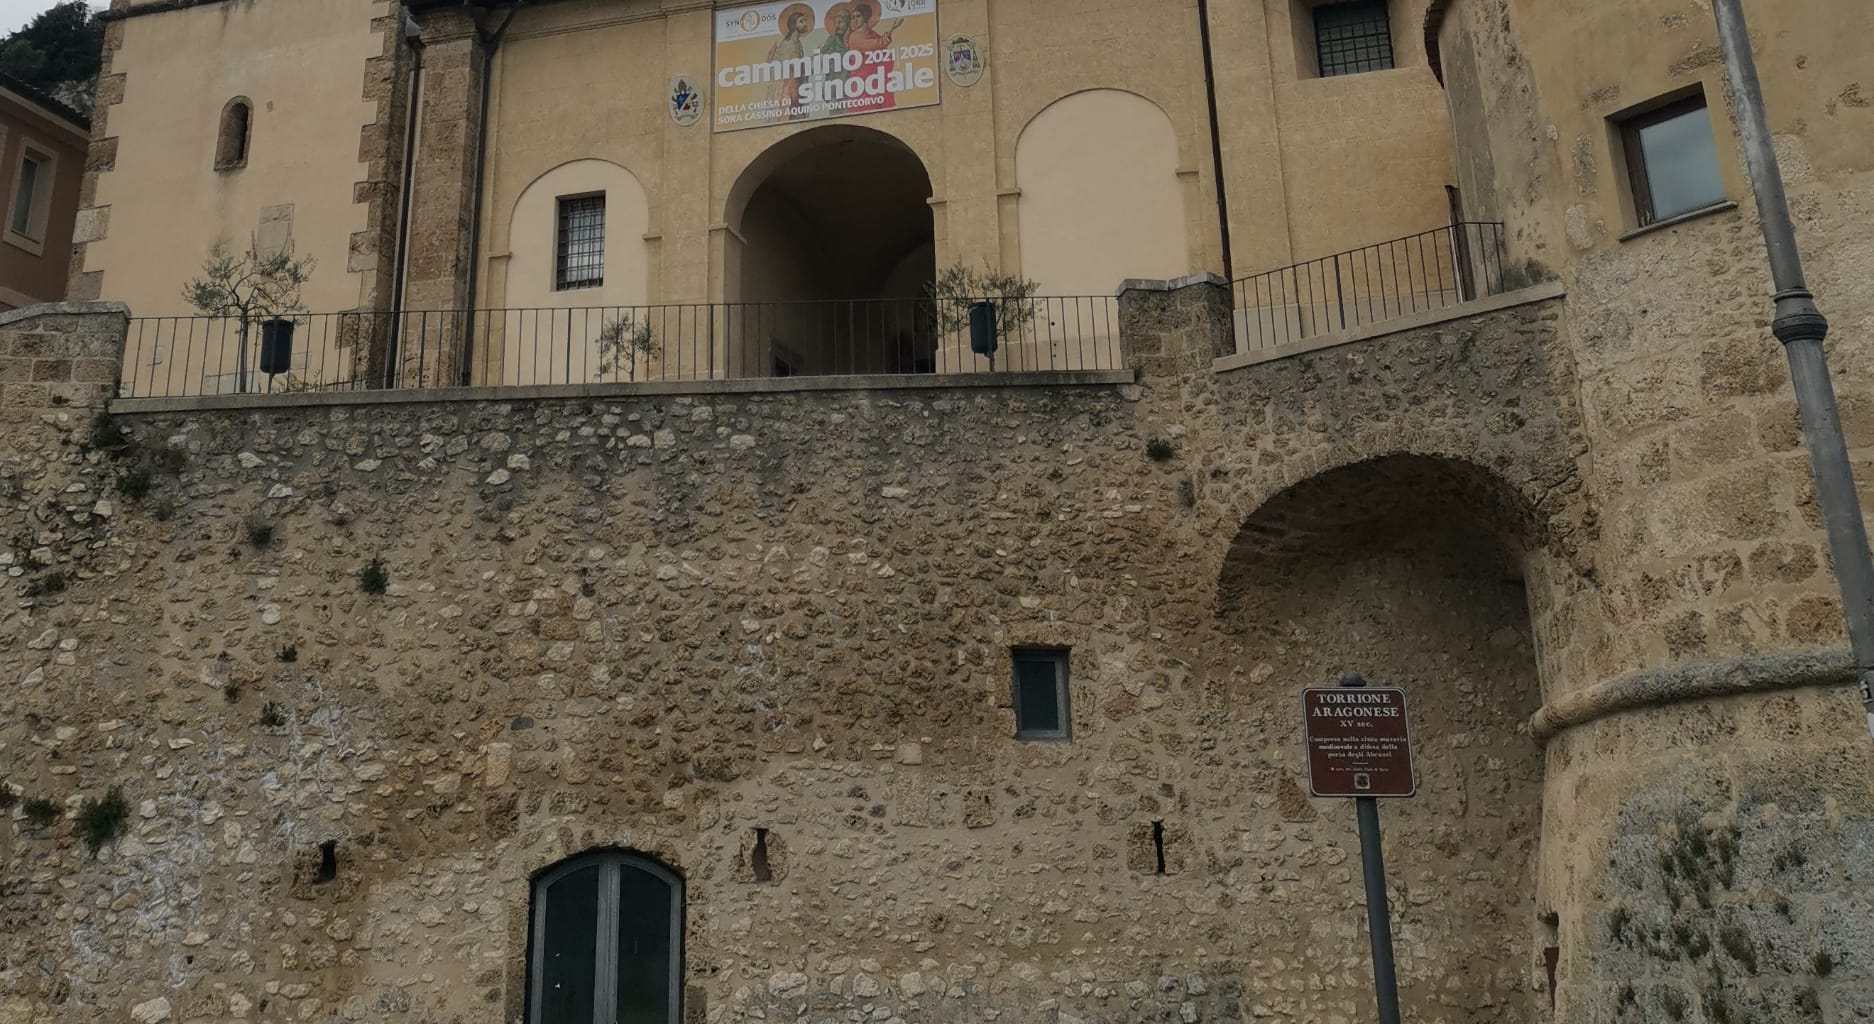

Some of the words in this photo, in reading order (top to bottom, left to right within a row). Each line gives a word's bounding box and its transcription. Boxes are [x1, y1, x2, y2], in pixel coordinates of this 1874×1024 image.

[718, 48, 863, 88] cammino
[865, 50, 896, 65] 2021
[901, 43, 934, 60] 2025
[798, 62, 934, 104] sinodale
[718, 114, 742, 125] SORA
[745, 109, 783, 122] CASSINO
[784, 103, 820, 117] AQUINO
[822, 96, 885, 112] PONTECORVO
[719, 104, 745, 115] DELLA
[748, 99, 780, 112] CHIESA
[782, 97, 791, 106] DI
[1316, 693, 1391, 704] TORRIONE
[1311, 706, 1399, 717] ARAGONESE
